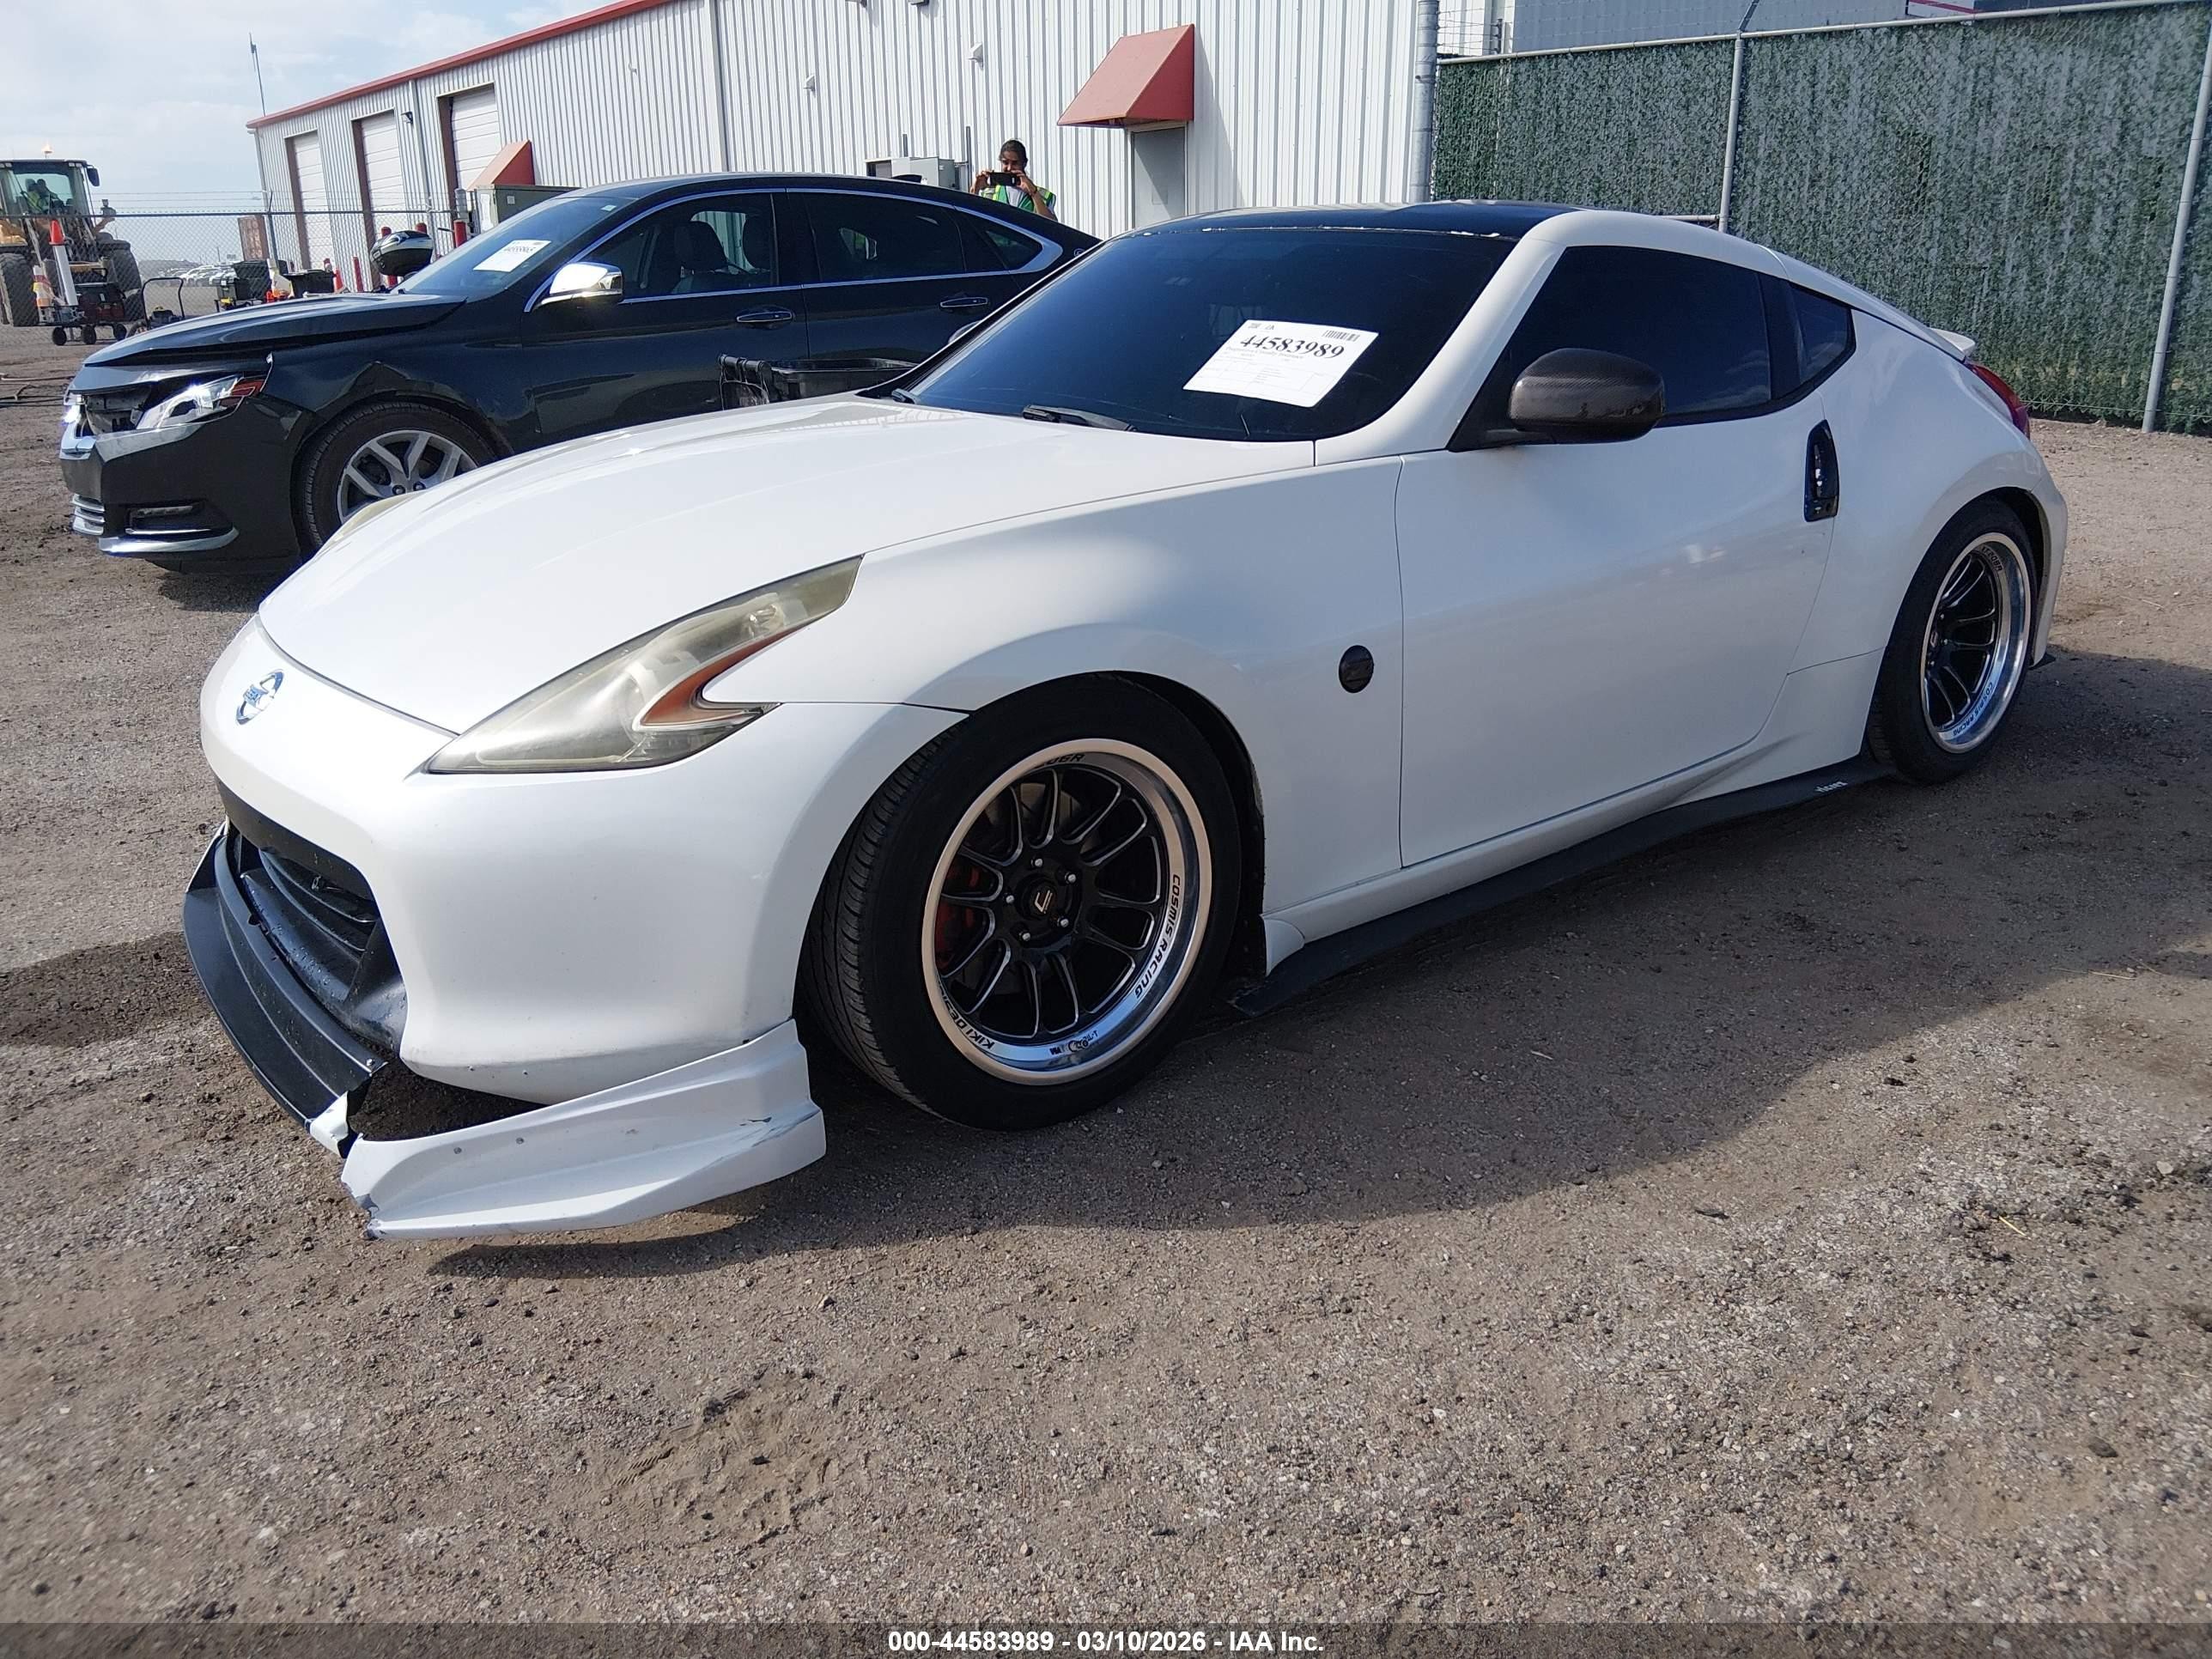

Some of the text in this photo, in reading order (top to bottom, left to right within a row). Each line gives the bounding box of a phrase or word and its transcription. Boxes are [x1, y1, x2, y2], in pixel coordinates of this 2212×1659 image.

[1240, 335, 1345, 359] 44583989
[1134, 873, 1181, 999] COSMIS RACING
[938, 980, 995, 1049] KIKI DESI
